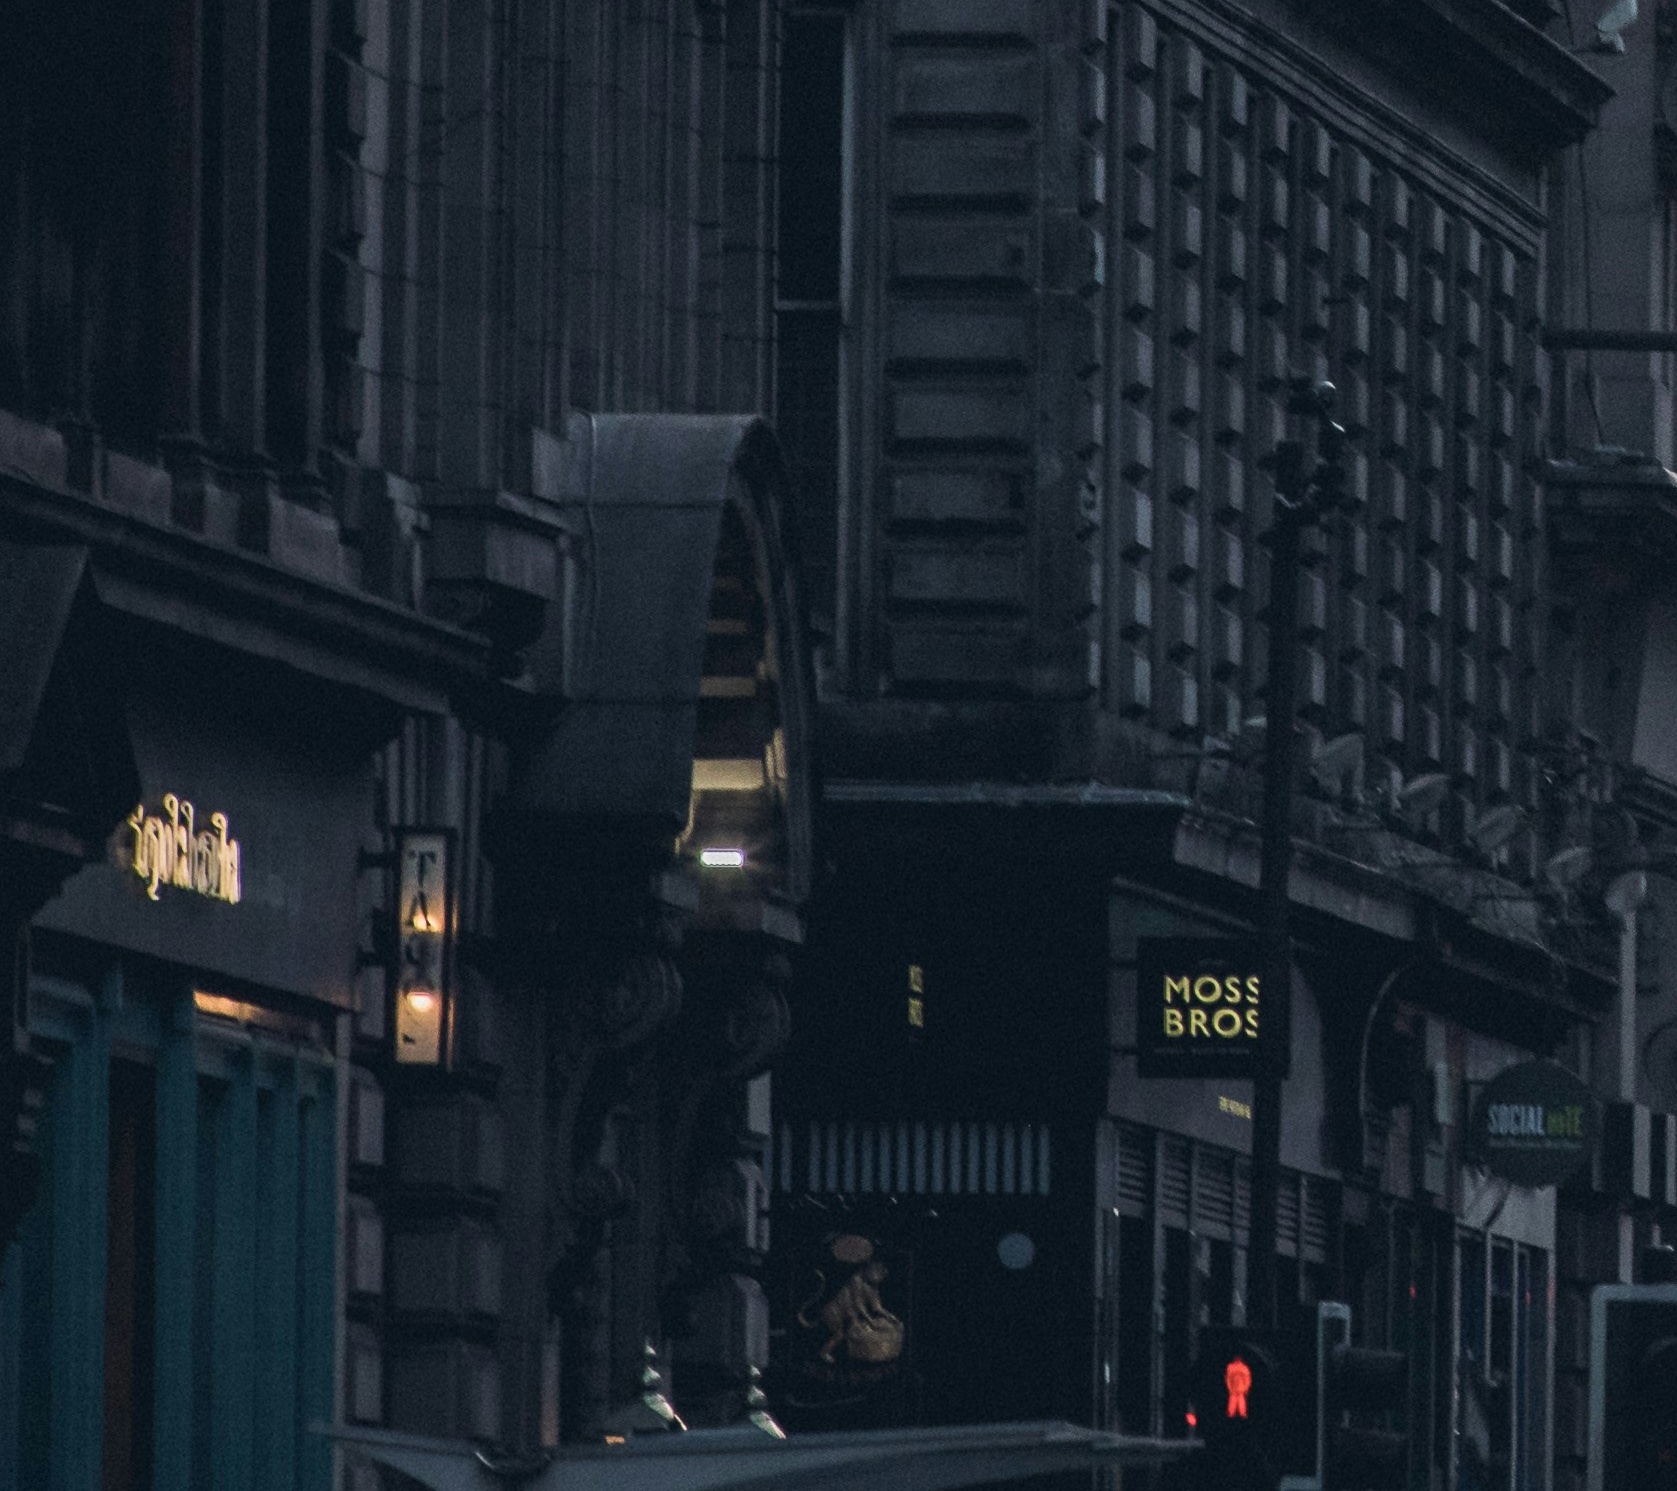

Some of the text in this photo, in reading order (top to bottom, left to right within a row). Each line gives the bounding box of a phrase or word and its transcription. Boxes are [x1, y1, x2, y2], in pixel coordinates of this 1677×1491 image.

[1163, 974, 1260, 1004] MOSS
[1163, 1007, 1259, 1038] BROS
[1487, 1104, 1545, 1135] SOCIAL
